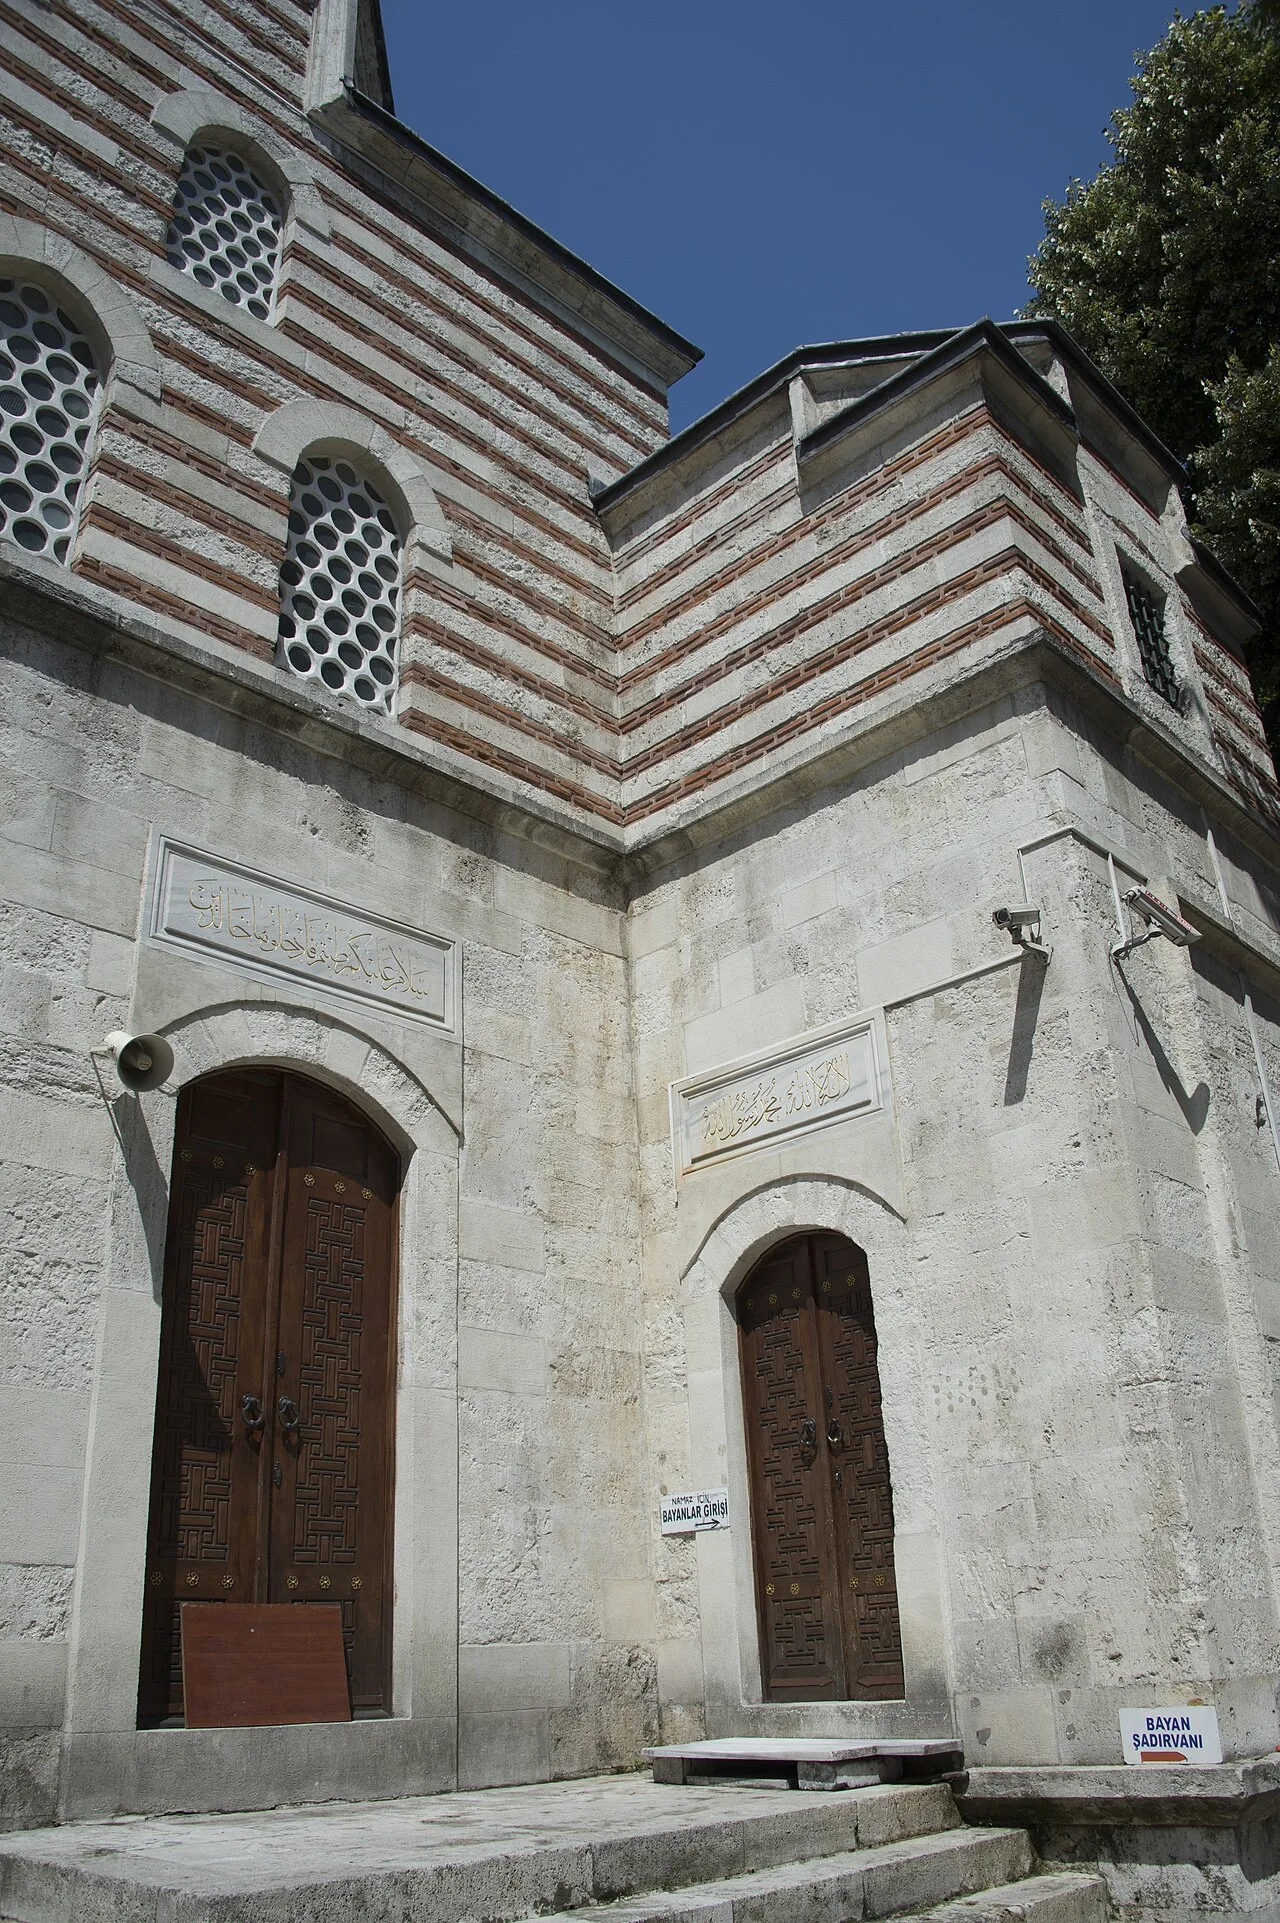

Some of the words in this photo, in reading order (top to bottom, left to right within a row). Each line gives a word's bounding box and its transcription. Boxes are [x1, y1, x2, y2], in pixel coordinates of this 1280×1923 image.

[663, 1505, 701, 1522] BAYANLAR
[703, 1499, 727, 1518] GİRİŞİ
[1146, 1717, 1191, 1731] BAYAN
[1132, 1733, 1203, 1750] ŞADIRVANI
